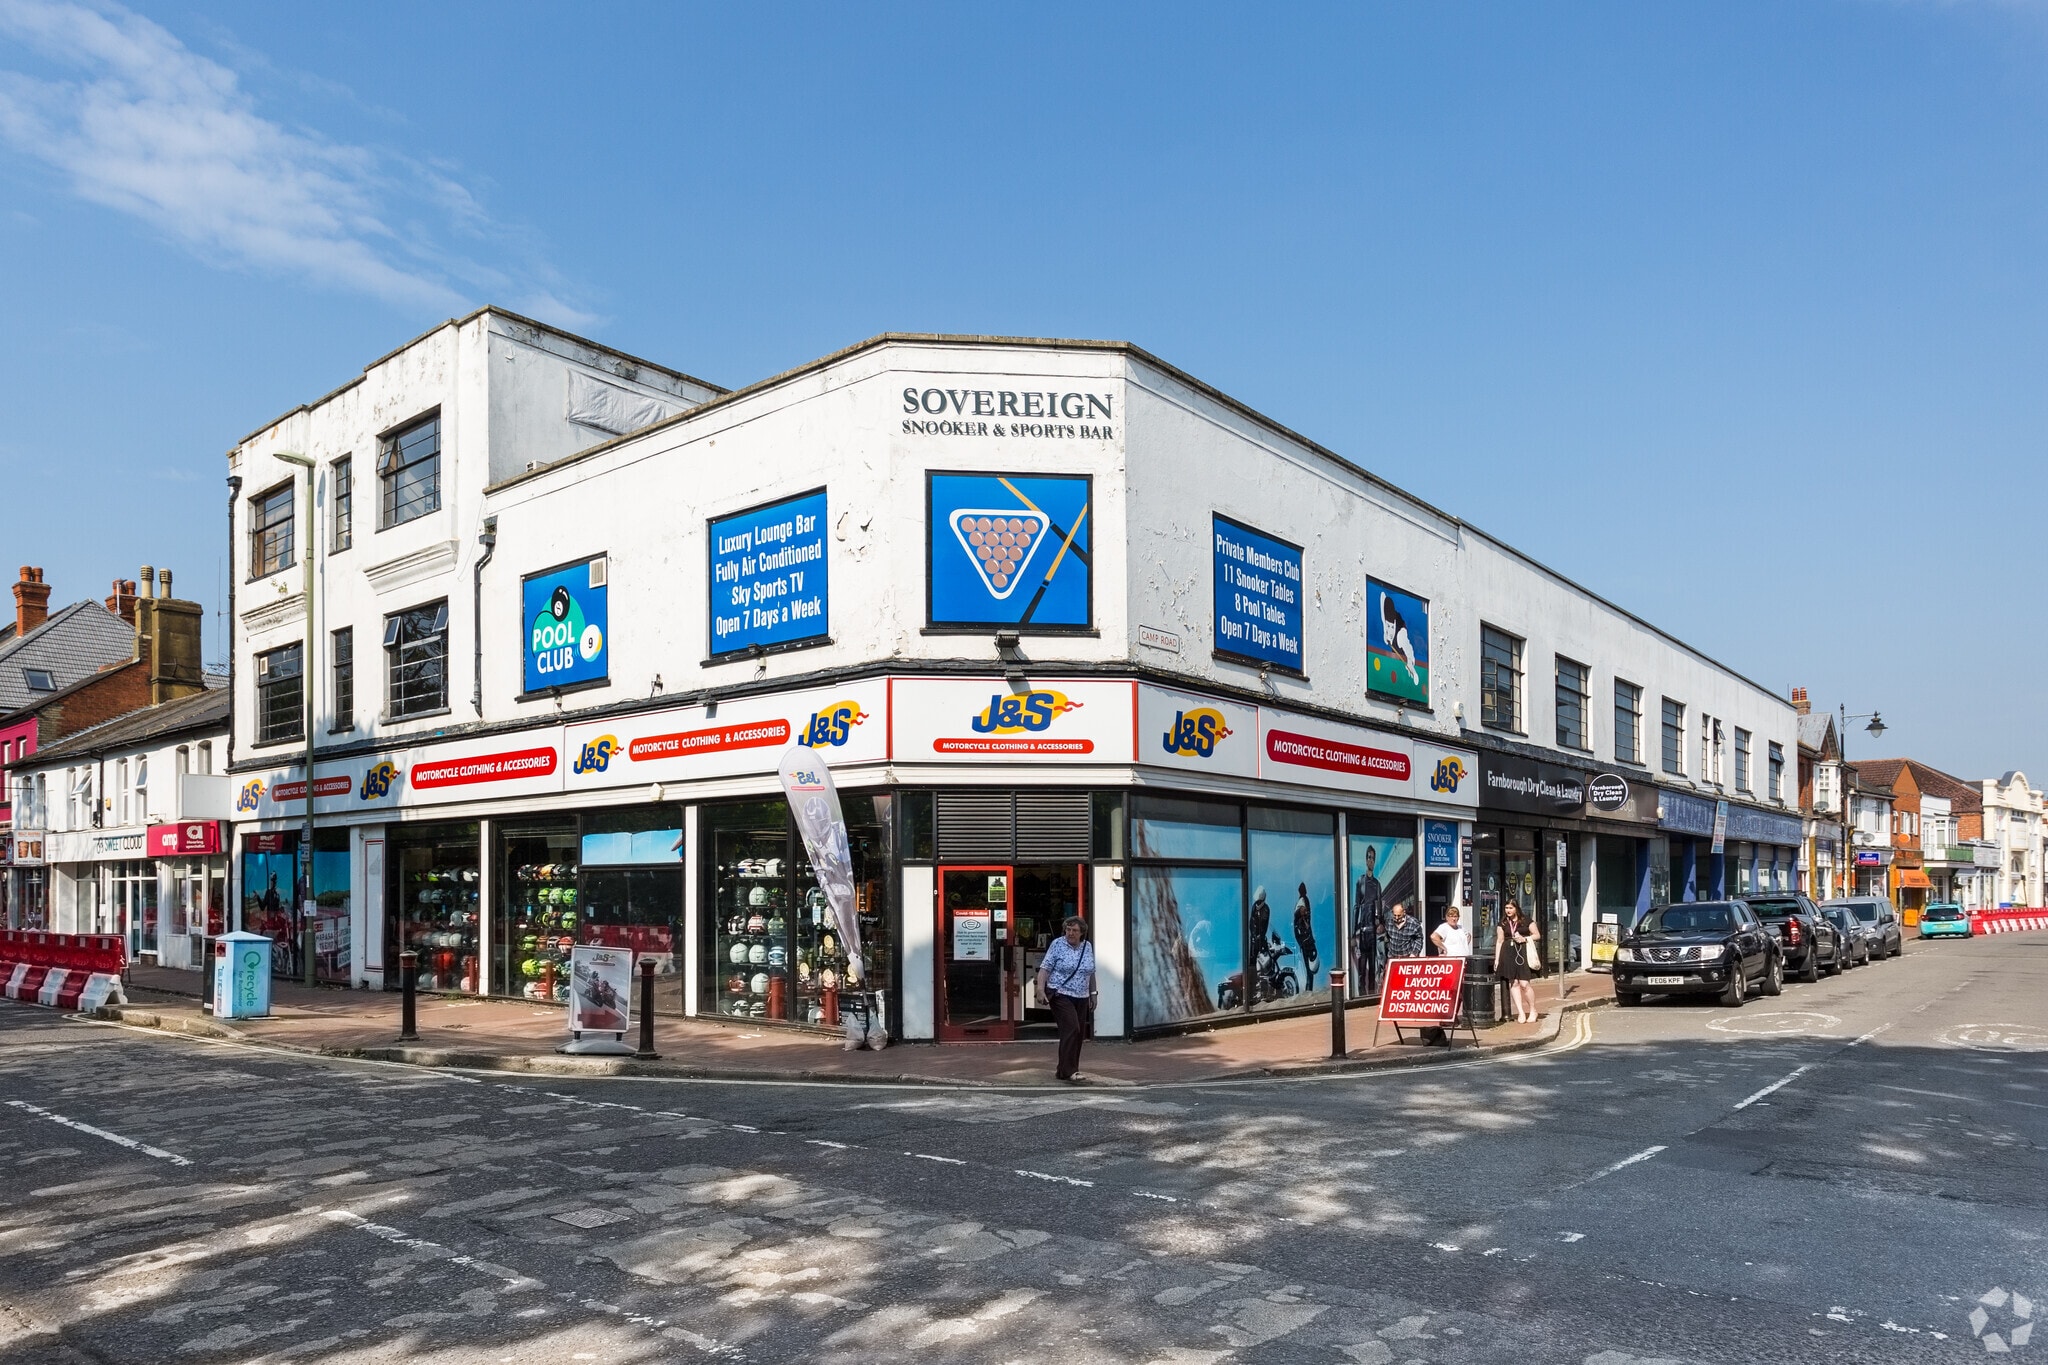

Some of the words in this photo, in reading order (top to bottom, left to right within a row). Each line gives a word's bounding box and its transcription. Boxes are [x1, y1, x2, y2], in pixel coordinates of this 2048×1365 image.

[902, 387, 1114, 420] SOVEREIGN
[902, 419, 988, 437] SNOOKER
[993, 422, 1006, 437] &
[1011, 423, 1075, 439] SPORTS
[1080, 424, 1114, 440] BAR
[718, 530, 753, 555] Luxury
[755, 519, 793, 546] Lounge
[795, 514, 816, 535] Bar
[716, 559, 740, 584] Fully
[742, 556, 757, 577] Air
[759, 539, 822, 572] Conditioned
[1216, 534, 1244, 562] Private
[1246, 547, 1283, 575] Members
[1284, 559, 1300, 582] Club
[731, 585, 751, 607] Sky
[753, 577, 788, 603] Sports
[790, 571, 804, 592] TV
[1224, 563, 1234, 583] 11
[1236, 567, 1269, 596] Snooker
[1270, 579, 1294, 604] Tables
[716, 613, 740, 639] Open
[743, 611, 750, 630] 7
[753, 607, 779, 630] Days
[782, 607, 788, 622] a
[791, 596, 821, 621] Week
[1235, 594, 1241, 611] 8
[1243, 595, 1261, 617] Pool
[1261, 601, 1286, 626] Tables
[532, 620, 575, 652] POOL
[588, 636, 594, 649] 9
[1141, 630, 1159, 645] CAMP
[1160, 634, 1178, 648] ROAD
[1221, 615, 1242, 640] Open
[1244, 622, 1251, 639] 7
[1252, 625, 1271, 649] Days
[1272, 634, 1277, 646] a
[1279, 632, 1298, 655] Week
[537, 646, 574, 674] CLUB
[798, 708, 852, 749] J&S
[972, 693, 1054, 734] J&S
[632, 739, 679, 754] MOTORCYCLE
[681, 734, 721, 749] CLOTHING
[725, 732, 732, 743] &
[733, 725, 786, 742] ACCESSORIES
[942, 742, 990, 751] MOTORCYCLE
[991, 743, 1029, 751] CLOTHING
[1030, 743, 1036, 751] &
[1037, 743, 1084, 751] ACCESSORIES
[1162, 710, 1216, 758] J&S
[415, 767, 459, 782] MOTORCYCLE
[459, 762, 495, 778] CLOTHING
[496, 761, 502, 773] &
[503, 755, 550, 773] ACCESSORIES
[573, 741, 611, 775] J&S
[1274, 740, 1325, 760] MOTORCYCLE
[1325, 749, 1361, 766] CLOTHING
[1361, 755, 1367, 767] &
[1367, 755, 1406, 773] ACCESSORIES
[275, 787, 299, 798] MOTORCYCLE
[300, 785, 319, 795] CLONG
[323, 781, 350, 791] ACCESSORIES
[360, 765, 390, 801] J&S
[1431, 759, 1458, 794] J&S
[1487, 770, 1527, 795] Farnborough
[1527, 778, 1540, 797] Dry
[1540, 780, 1556, 797] Clean
[1557, 784, 1561, 798] &
[1562, 784, 1582, 804] Laundry
[236, 783, 260, 812] J&S
[105, 837, 122, 851] SWEET
[123, 836, 142, 849] CLOUD
[1427, 833, 1452, 843] SNOOKER
[1433, 847, 1447, 856] POOL
[592, 953, 610, 961] J&S
[1398, 965, 1422, 975] NEW
[1424, 965, 1453, 975] ROAD
[244, 970, 257, 1007] recycle
[1390, 991, 1411, 1000] FOR
[1414, 990, 1452, 1000] SOCIAL
[1404, 978, 1442, 988] LAYOUT
[1650, 977, 1667, 985] FE06
[1668, 977, 1683, 985] KPF
[1388, 1003, 1450, 1013] DISTANCING
